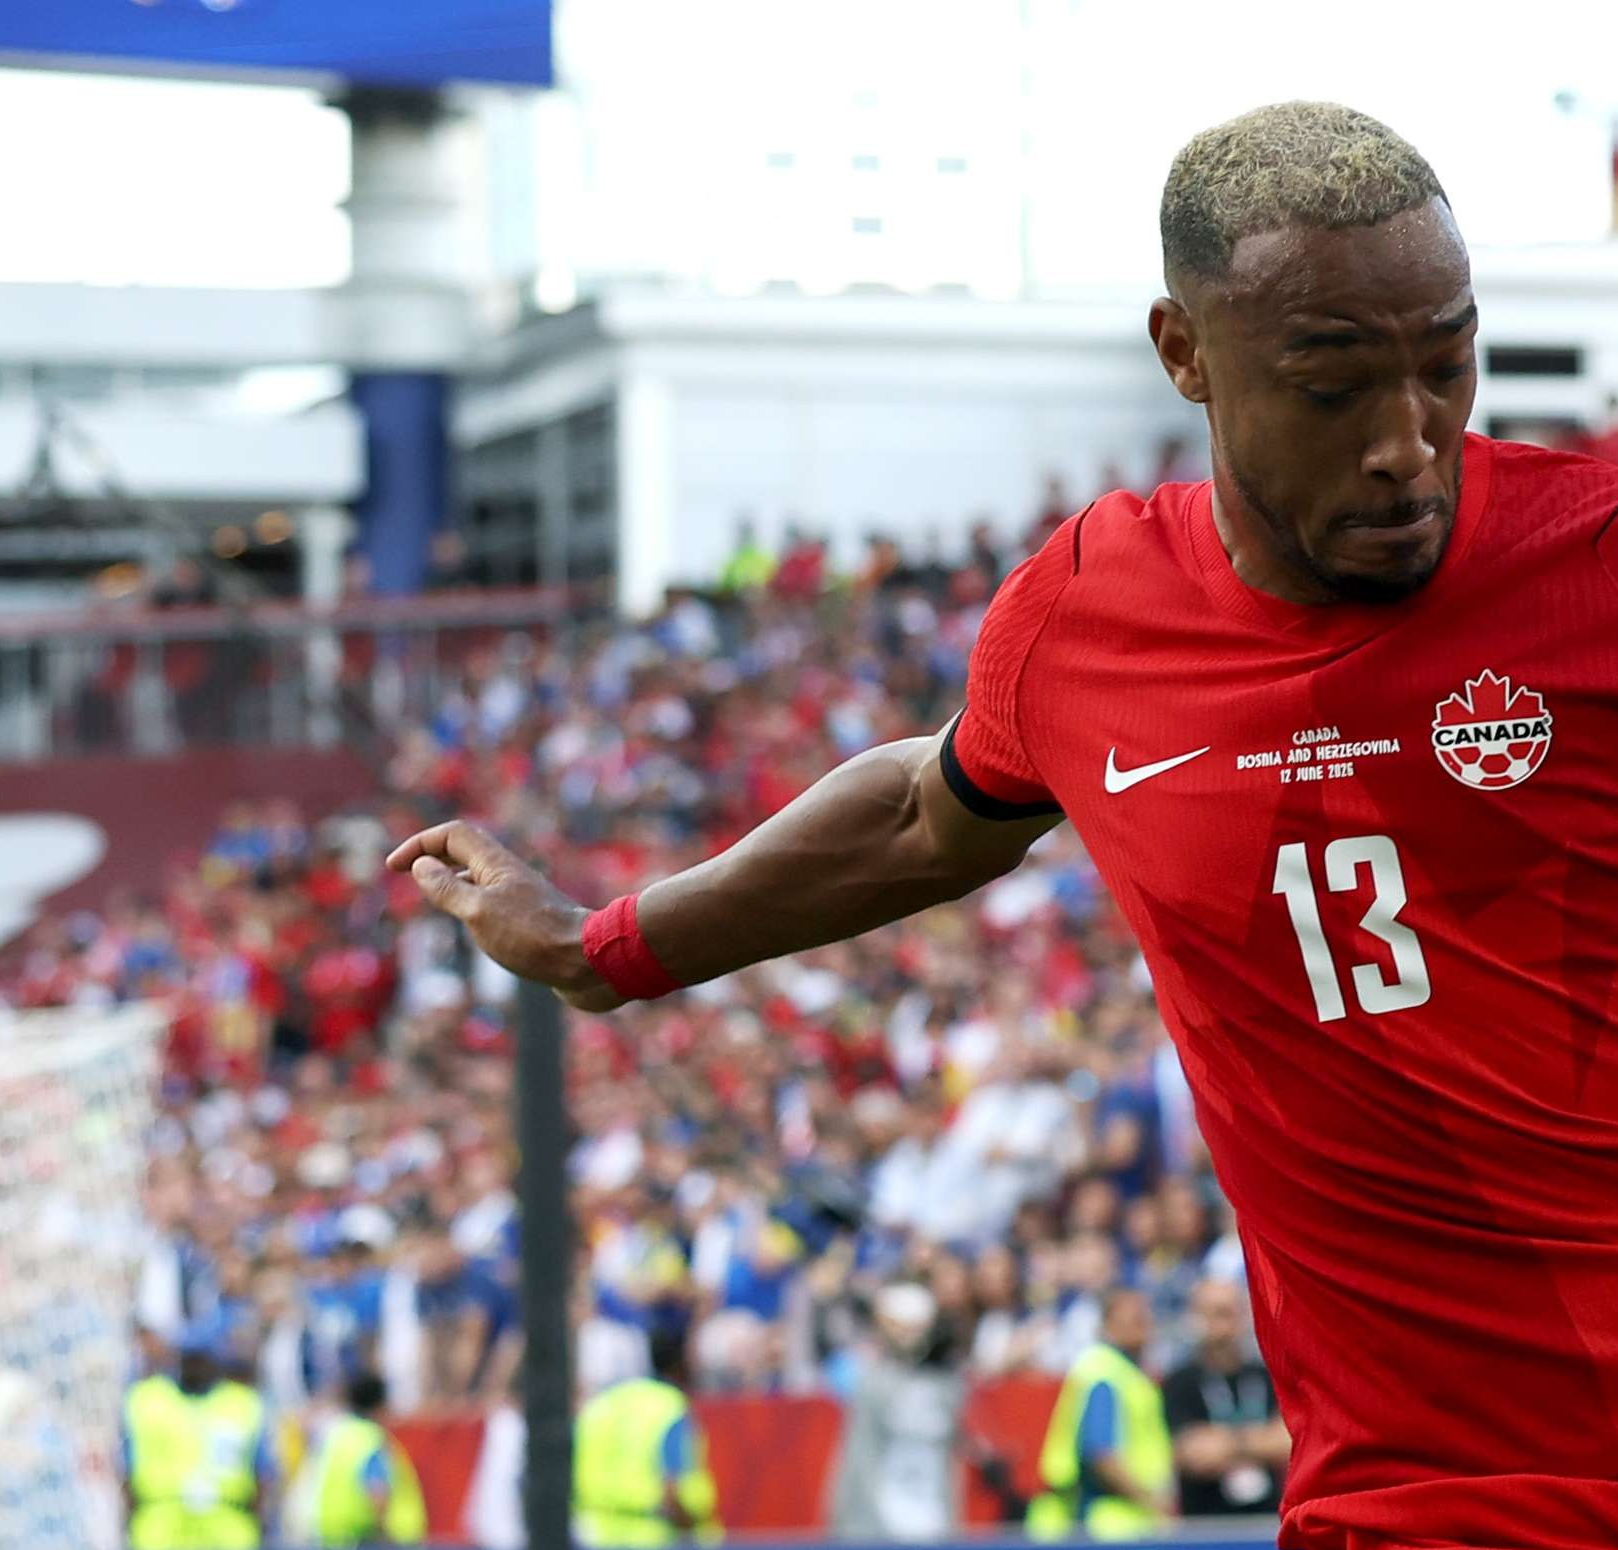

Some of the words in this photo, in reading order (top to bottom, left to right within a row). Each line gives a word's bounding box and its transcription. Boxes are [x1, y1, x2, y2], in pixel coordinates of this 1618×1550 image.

[1292, 725, 1341, 745] CANADA
[1435, 721, 1549, 747] CANADA
[1236, 751, 1282, 770] BOSNIA
[1286, 748, 1312, 764] AND
[1316, 738, 1401, 760] HERZEGOVINA
[1279, 768, 1292, 784] 12
[1295, 766, 1324, 782] JUNE
[1272, 834, 1433, 1023] 13
